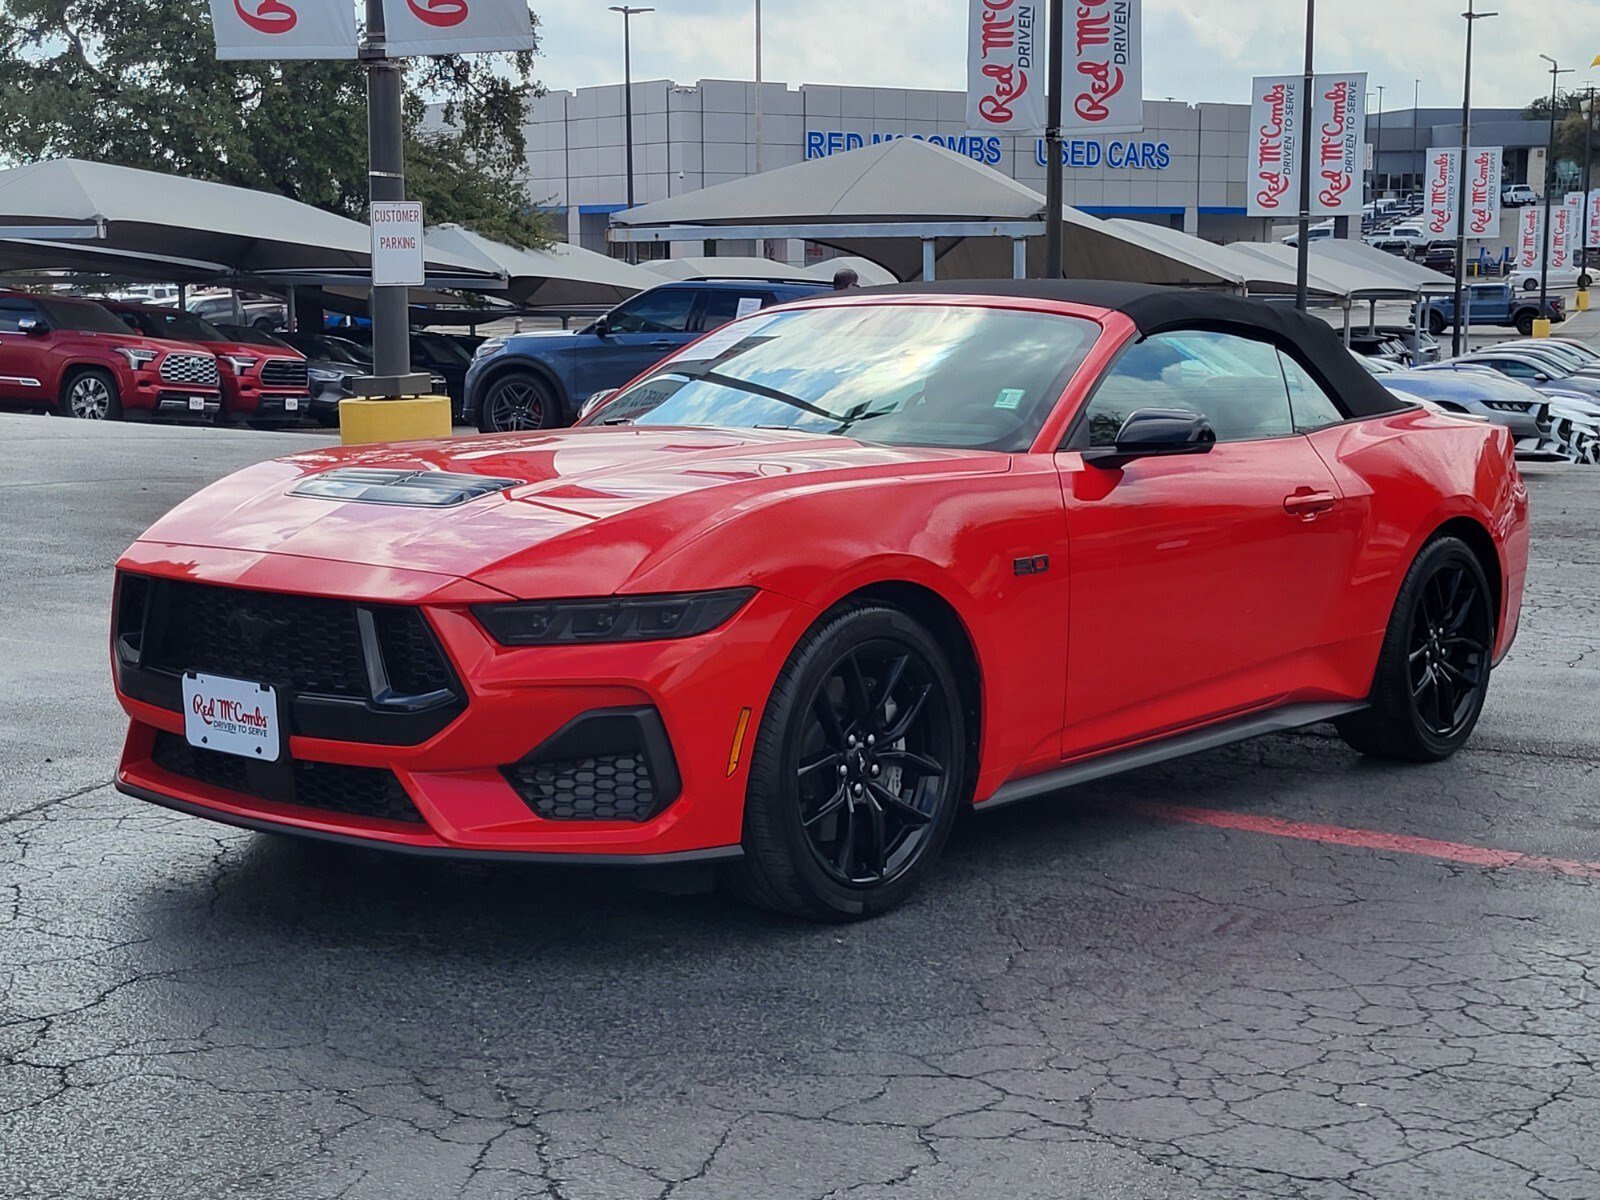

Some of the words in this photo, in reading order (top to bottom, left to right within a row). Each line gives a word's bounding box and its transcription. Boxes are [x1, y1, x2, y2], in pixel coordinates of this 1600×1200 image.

[1018, 5, 1031, 69] DRIVEN
[1113, 1, 1127, 65] DRIVEN
[979, 63, 1028, 124] Red
[1074, 60, 1124, 122] Red
[1285, 83, 1295, 116] SERVE
[1346, 80, 1357, 114] SERVE
[1258, 83, 1285, 168] McCombs
[1284, 118, 1293, 133] TO
[1320, 81, 1347, 168] McCombs
[1346, 116, 1355, 131] TO
[807, 131, 864, 159] RED
[1108, 141, 1171, 168] CARS
[1282, 135, 1292, 175] DRIVEN
[1344, 134, 1355, 174] DRIVEN
[1256, 171, 1289, 209] Red
[1318, 170, 1351, 208] Red
[1431, 153, 1448, 207] McCombs
[1448, 175, 1455, 185] TO
[1472, 152, 1489, 207] McCombs
[1488, 174, 1496, 184] TO
[374, 209, 420, 223] CUSTOMER
[1429, 208, 1451, 233] Red
[1470, 208, 1492, 233] Red
[380, 236, 416, 250] PARKING
[192, 693, 216, 726] Red
[216, 698, 267, 729] McCombs
[213, 720, 237, 733] DRIVEN
[238, 724, 247, 734] TO
[248, 727, 268, 738] SERVE
